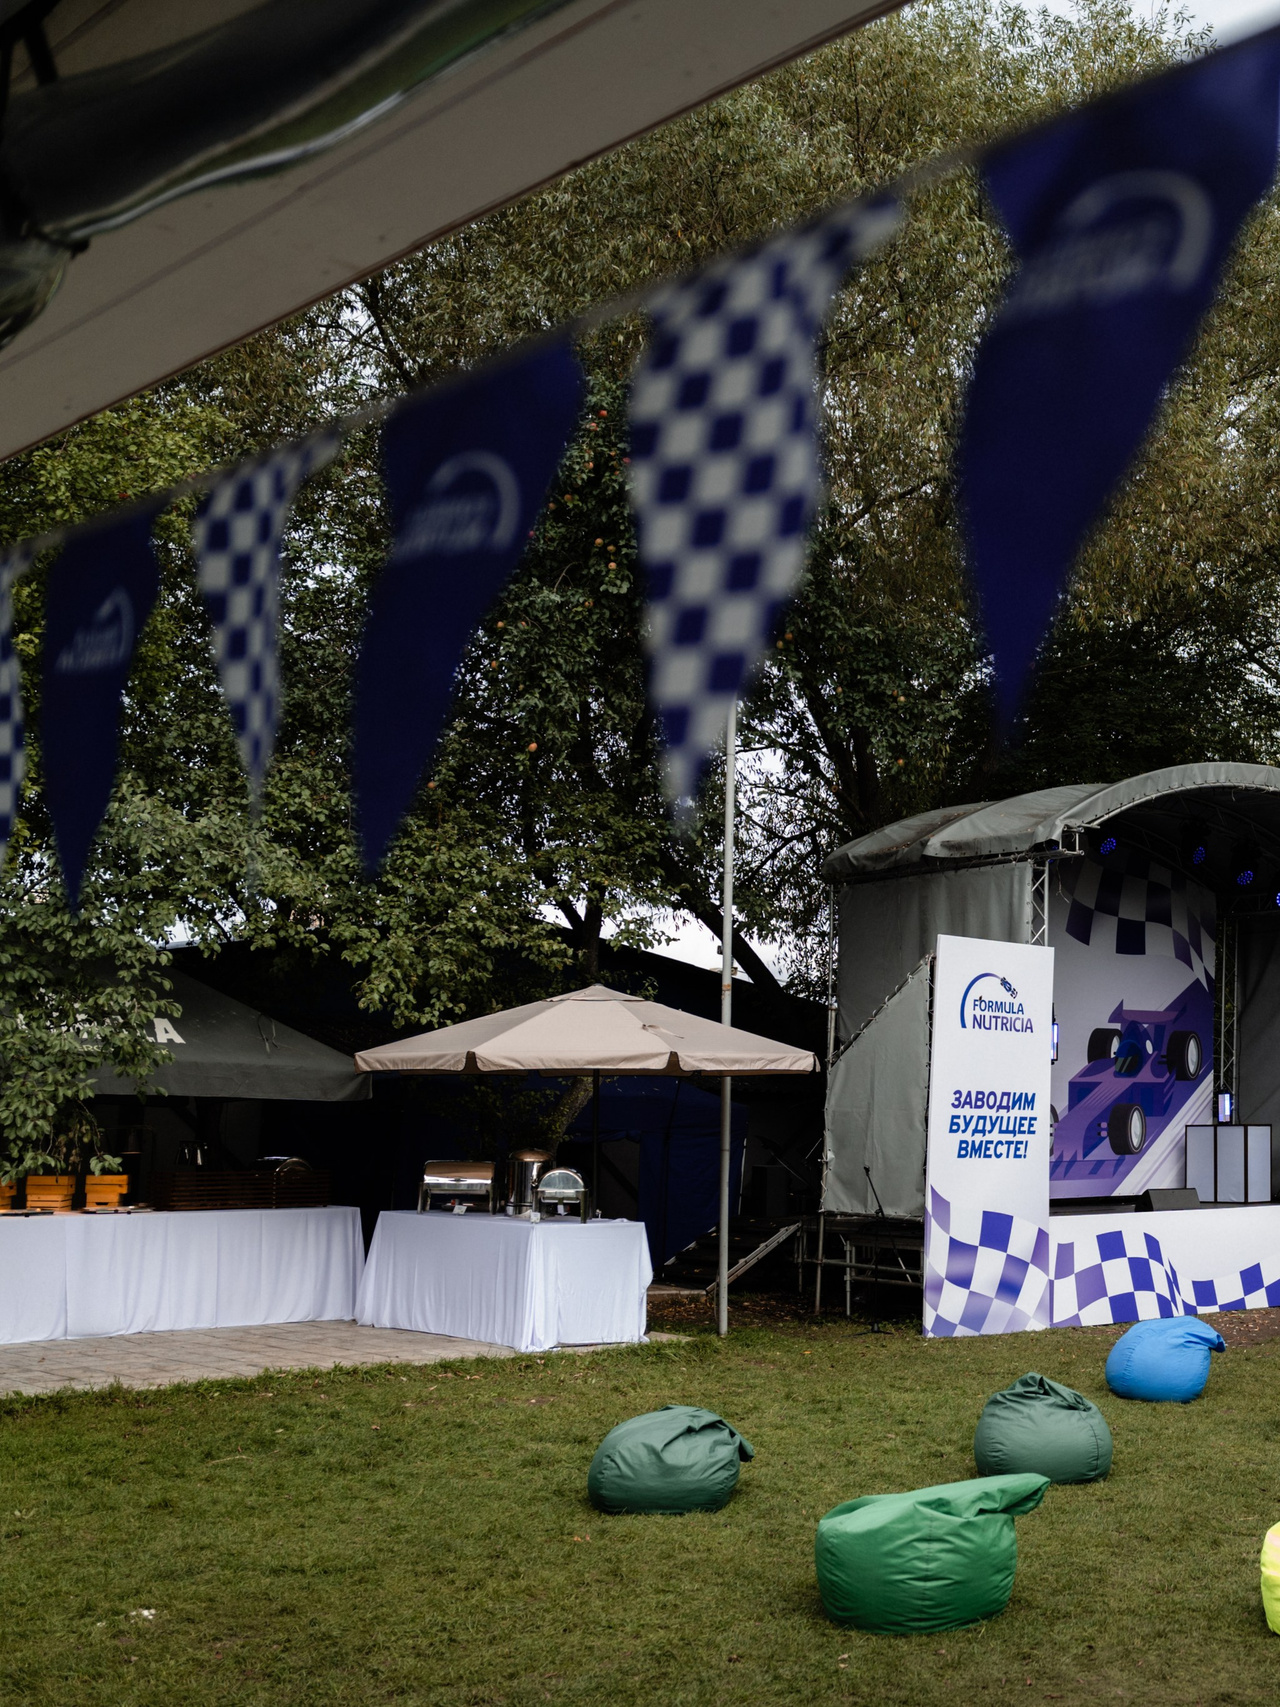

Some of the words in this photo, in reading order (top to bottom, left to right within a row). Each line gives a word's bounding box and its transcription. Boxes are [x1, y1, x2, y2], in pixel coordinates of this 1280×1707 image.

[973, 999, 1024, 1015] FORMULA
[972, 1015, 1034, 1033] NUTRICIA
[951, 1090, 1036, 1113] ЗАВОДИМ
[949, 1114, 1037, 1137] БУДУЩЕЕ
[957, 1140, 1028, 1159] ВМЕСТЕ!
